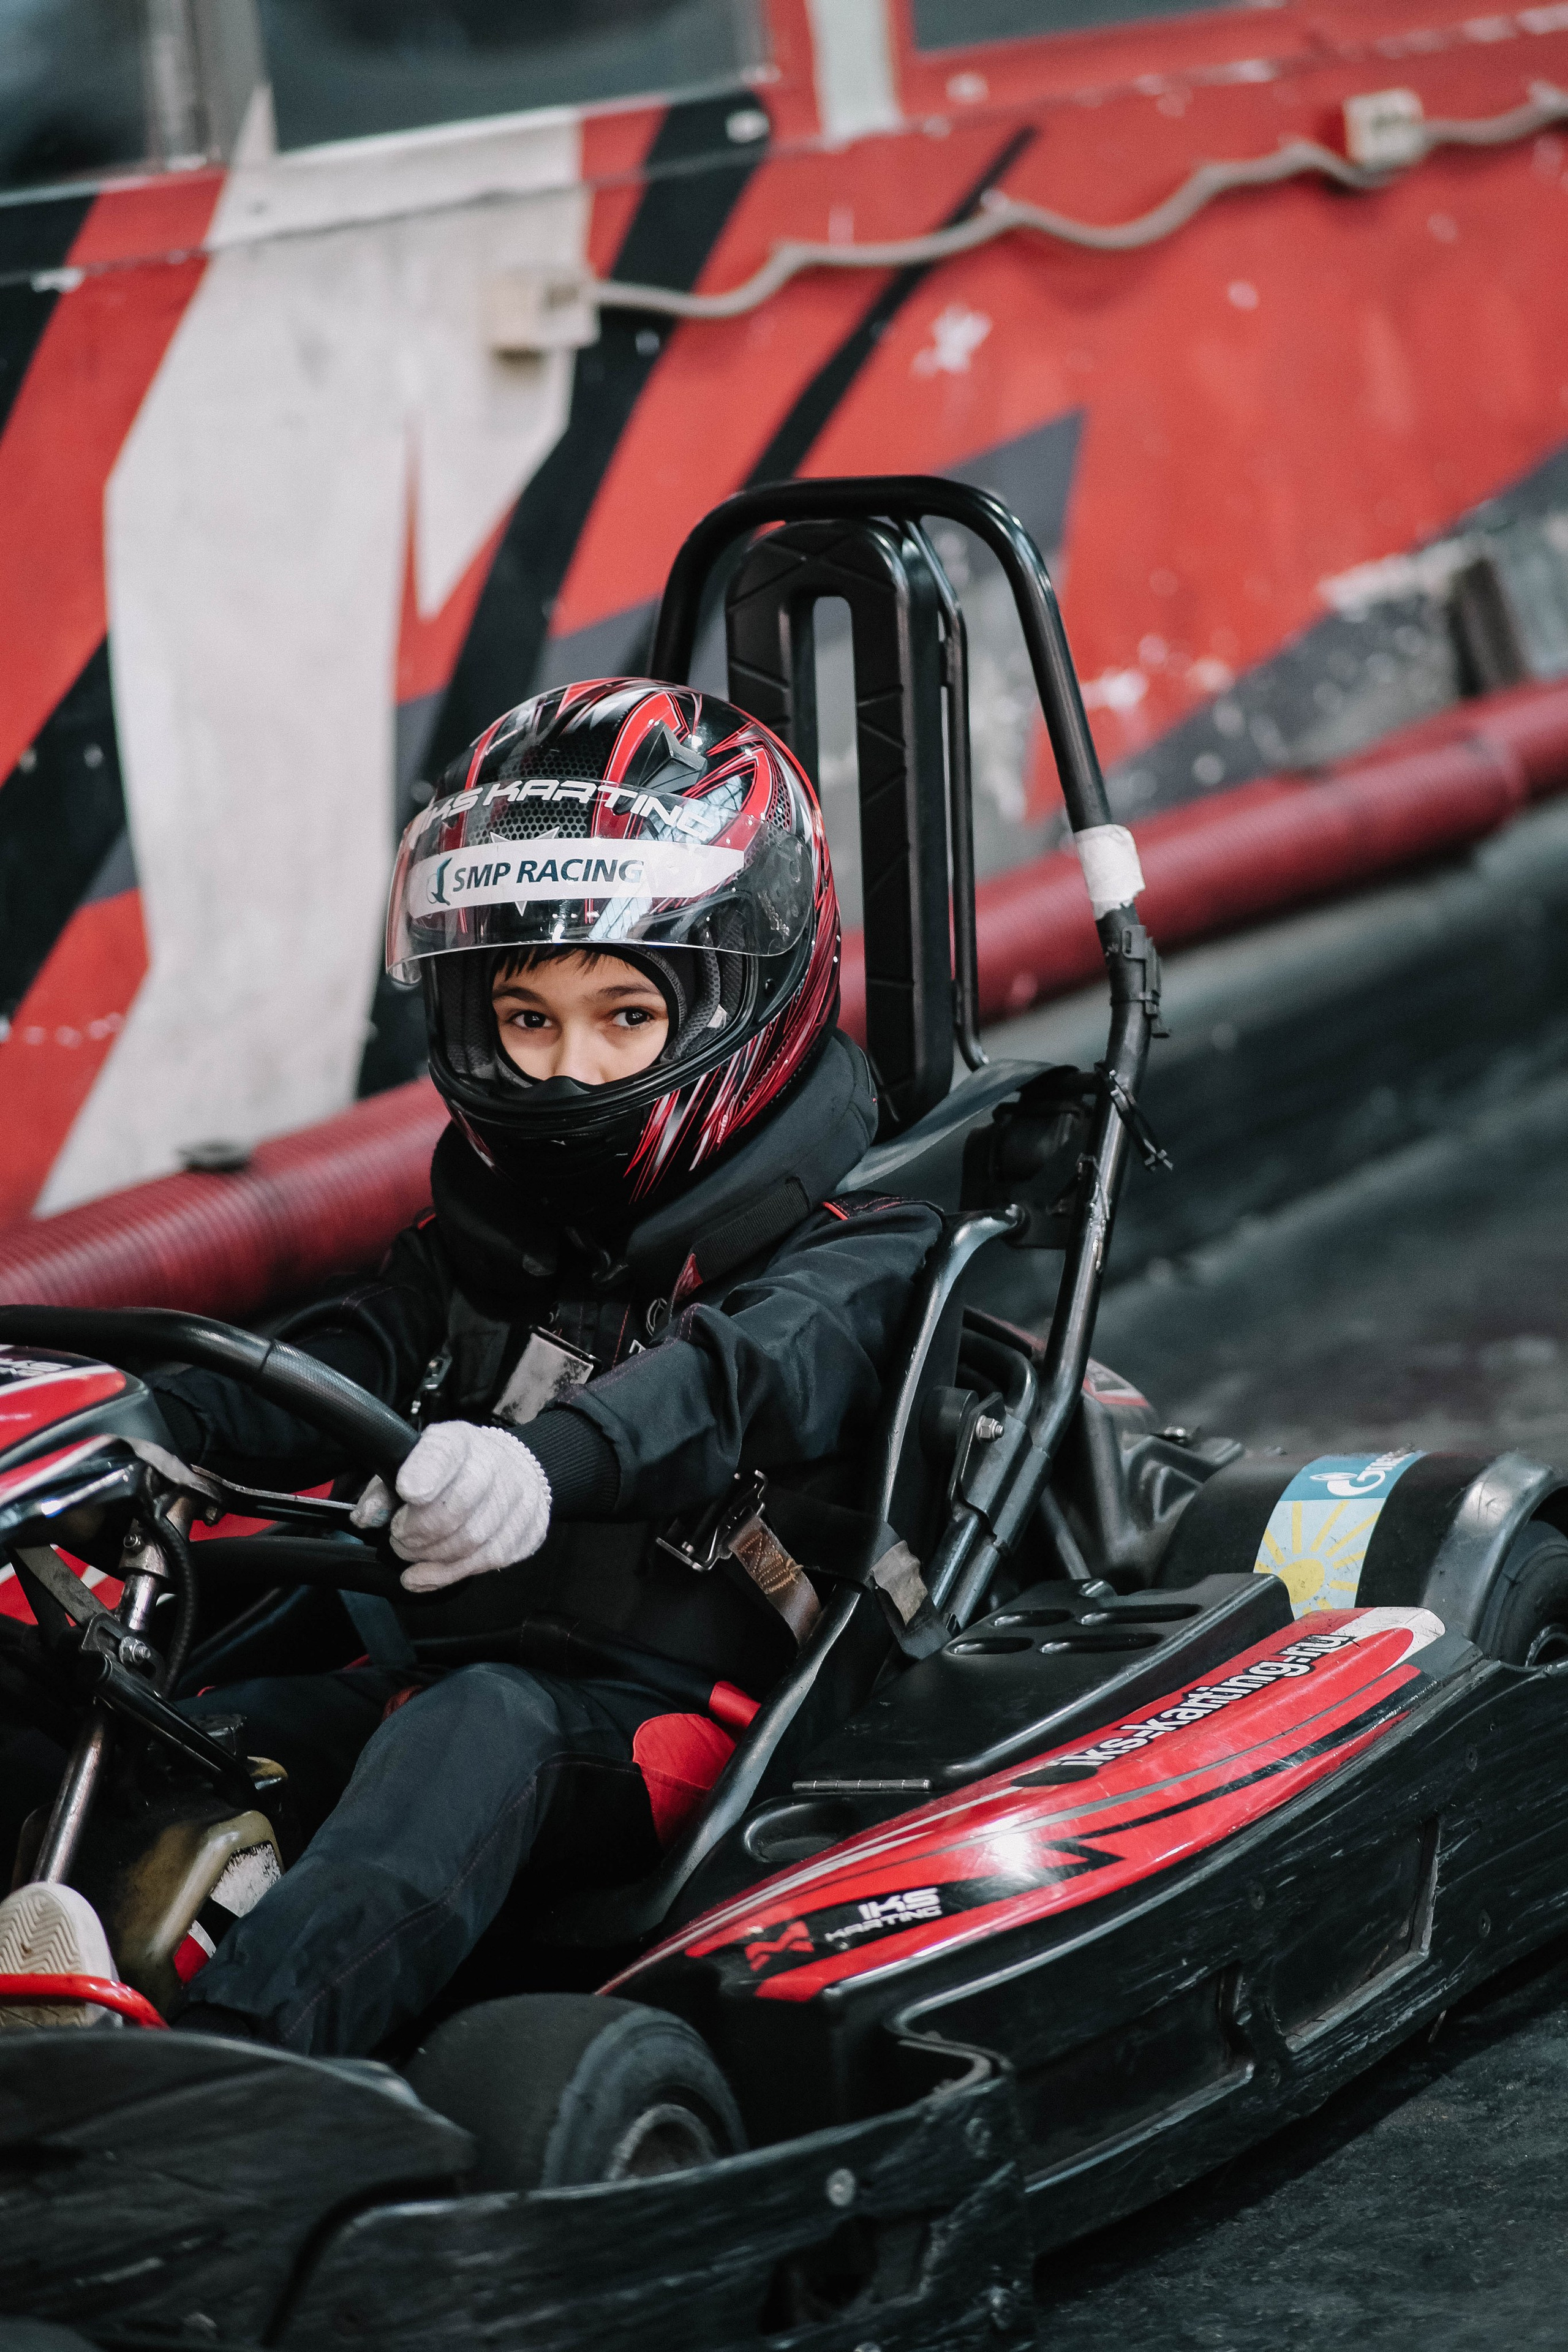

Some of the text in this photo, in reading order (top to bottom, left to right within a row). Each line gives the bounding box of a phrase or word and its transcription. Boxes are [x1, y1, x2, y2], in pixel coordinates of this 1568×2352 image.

[482, 779, 714, 842] KARTING
[452, 858, 644, 892] SMP RACING
[1046, 1634, 1351, 1766] iks-karting.ru
[858, 1887, 940, 1921] IKS
[824, 1905, 943, 1942] KARTING
